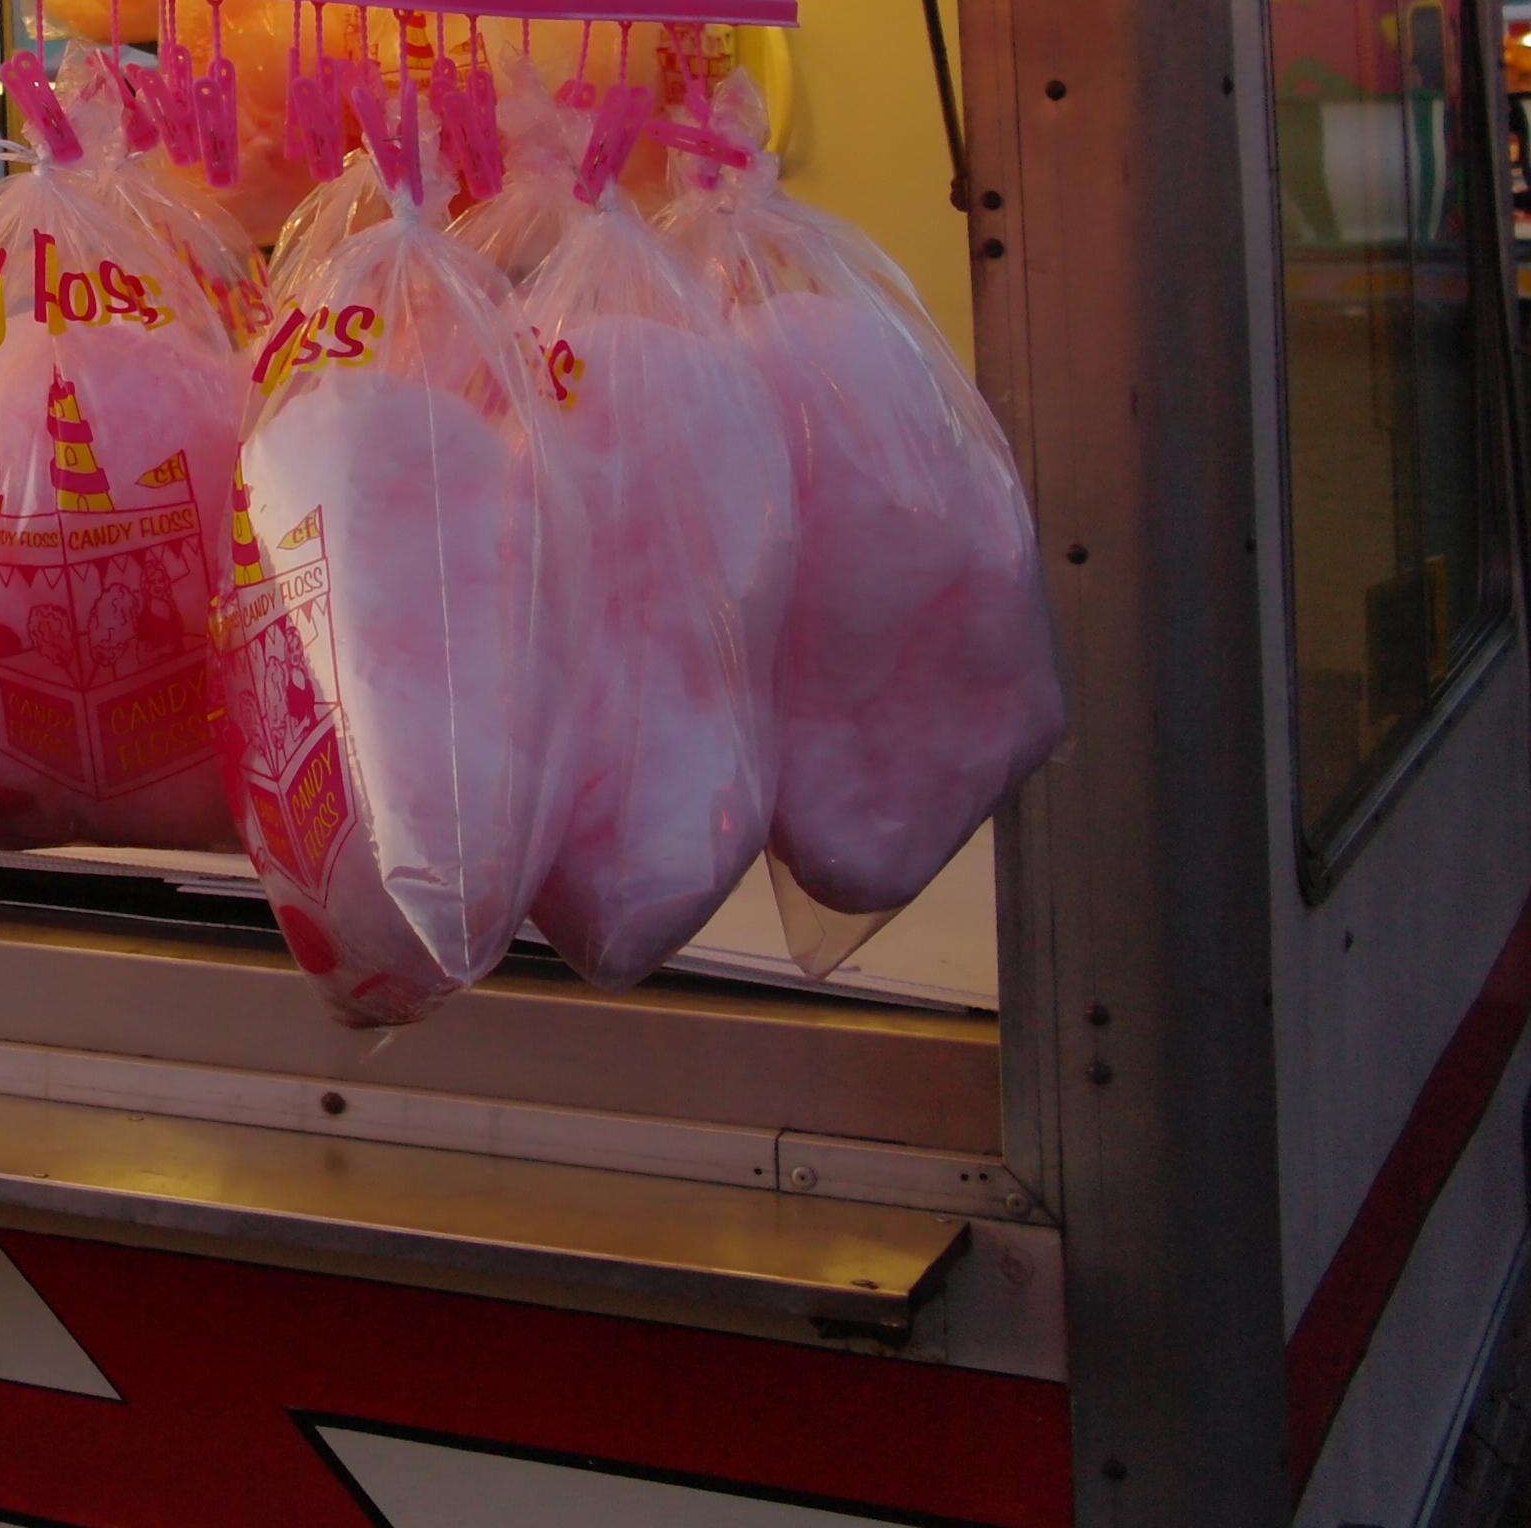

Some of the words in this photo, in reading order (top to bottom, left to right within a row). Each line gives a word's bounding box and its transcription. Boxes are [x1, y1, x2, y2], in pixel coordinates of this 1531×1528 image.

[20, 528, 59, 549] FLOSS
[68, 520, 136, 551] CANDY
[139, 509, 197, 540] FLOSS
[242, 589, 277, 629] CANDY
[279, 567, 324, 605] FLOSS
[8, 693, 74, 729] CANDY
[110, 667, 208, 736] CANDY
[119, 713, 209, 772] FLOSS
[291, 742, 333, 826] CANDY
[303, 793, 340, 867] FLOSS
